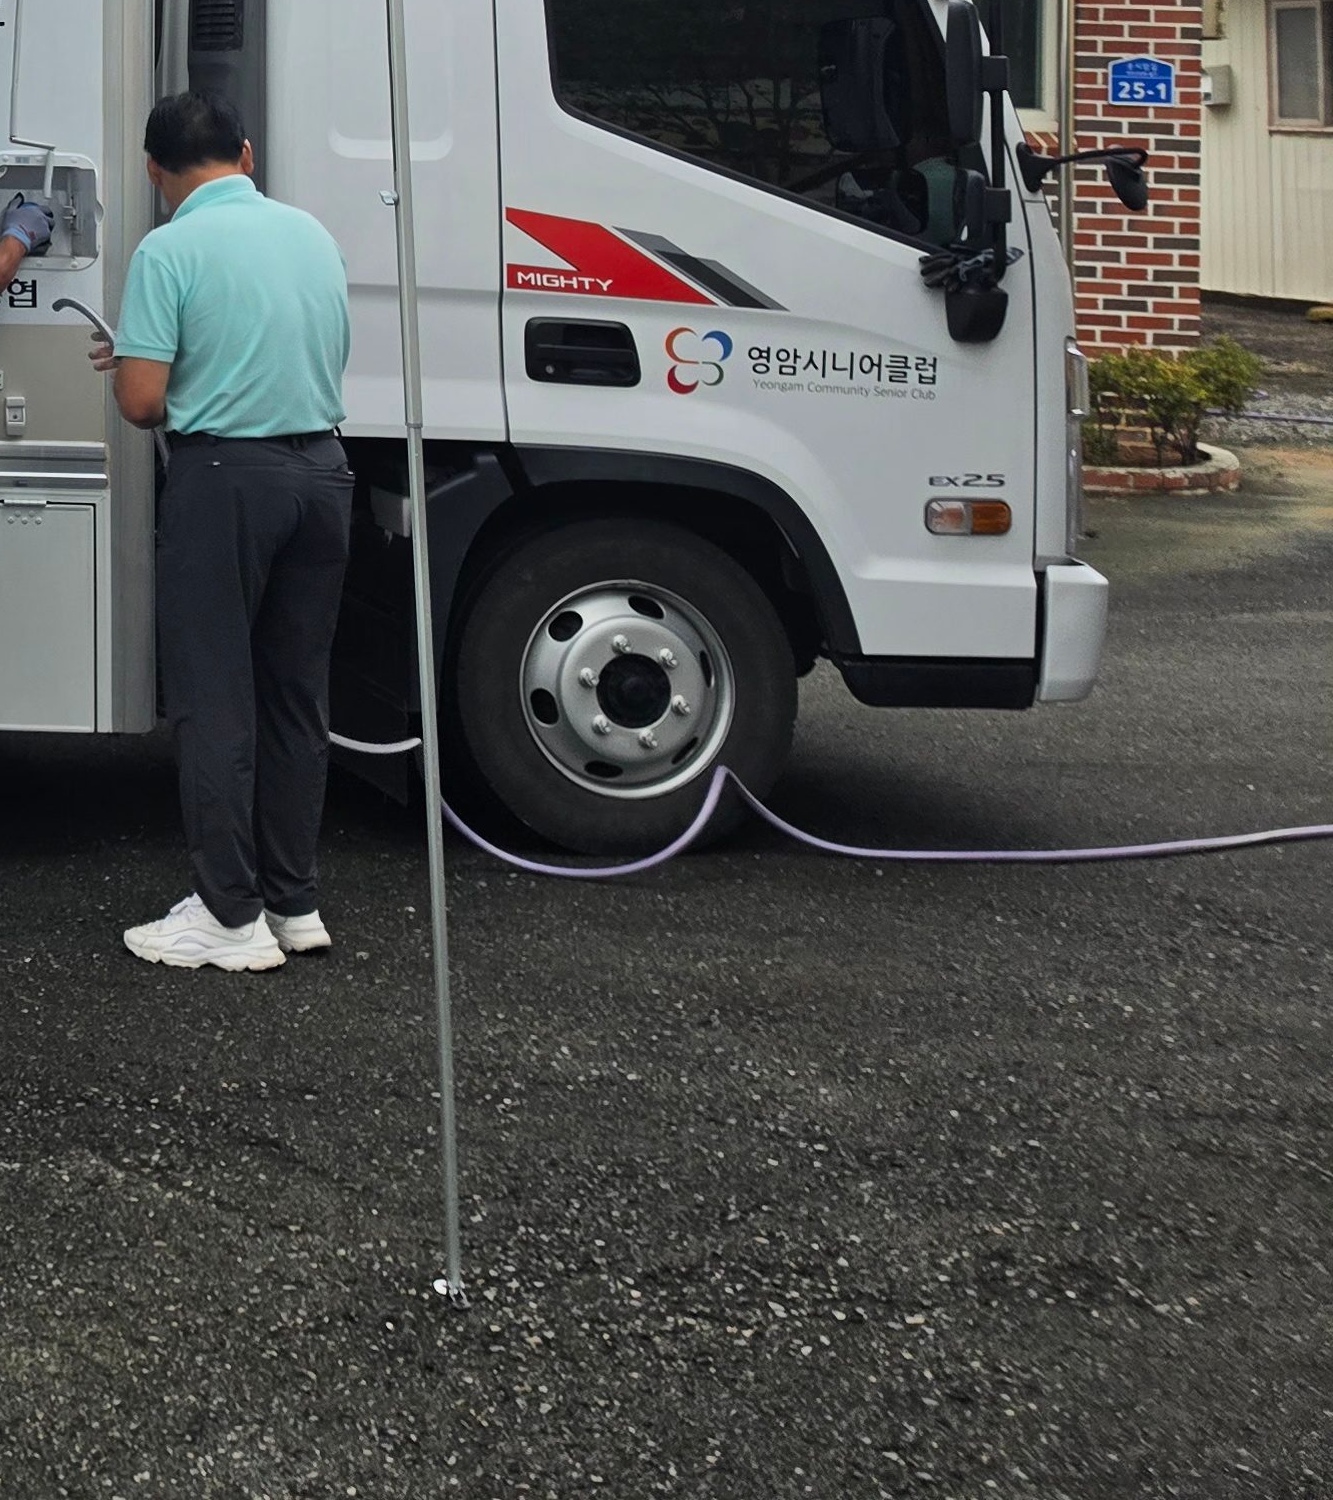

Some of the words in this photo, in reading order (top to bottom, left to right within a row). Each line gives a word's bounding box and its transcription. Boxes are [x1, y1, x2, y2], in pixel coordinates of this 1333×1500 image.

[1117, 81, 1167, 100] 25-1
[516, 271, 614, 292] MIGHTY
[747, 346, 938, 386] 영암시니어클럽
[753, 378, 805, 393] Yeongam
[807, 382, 871, 398] Community
[873, 386, 908, 398] Senior
[911, 387, 937, 401] Club
